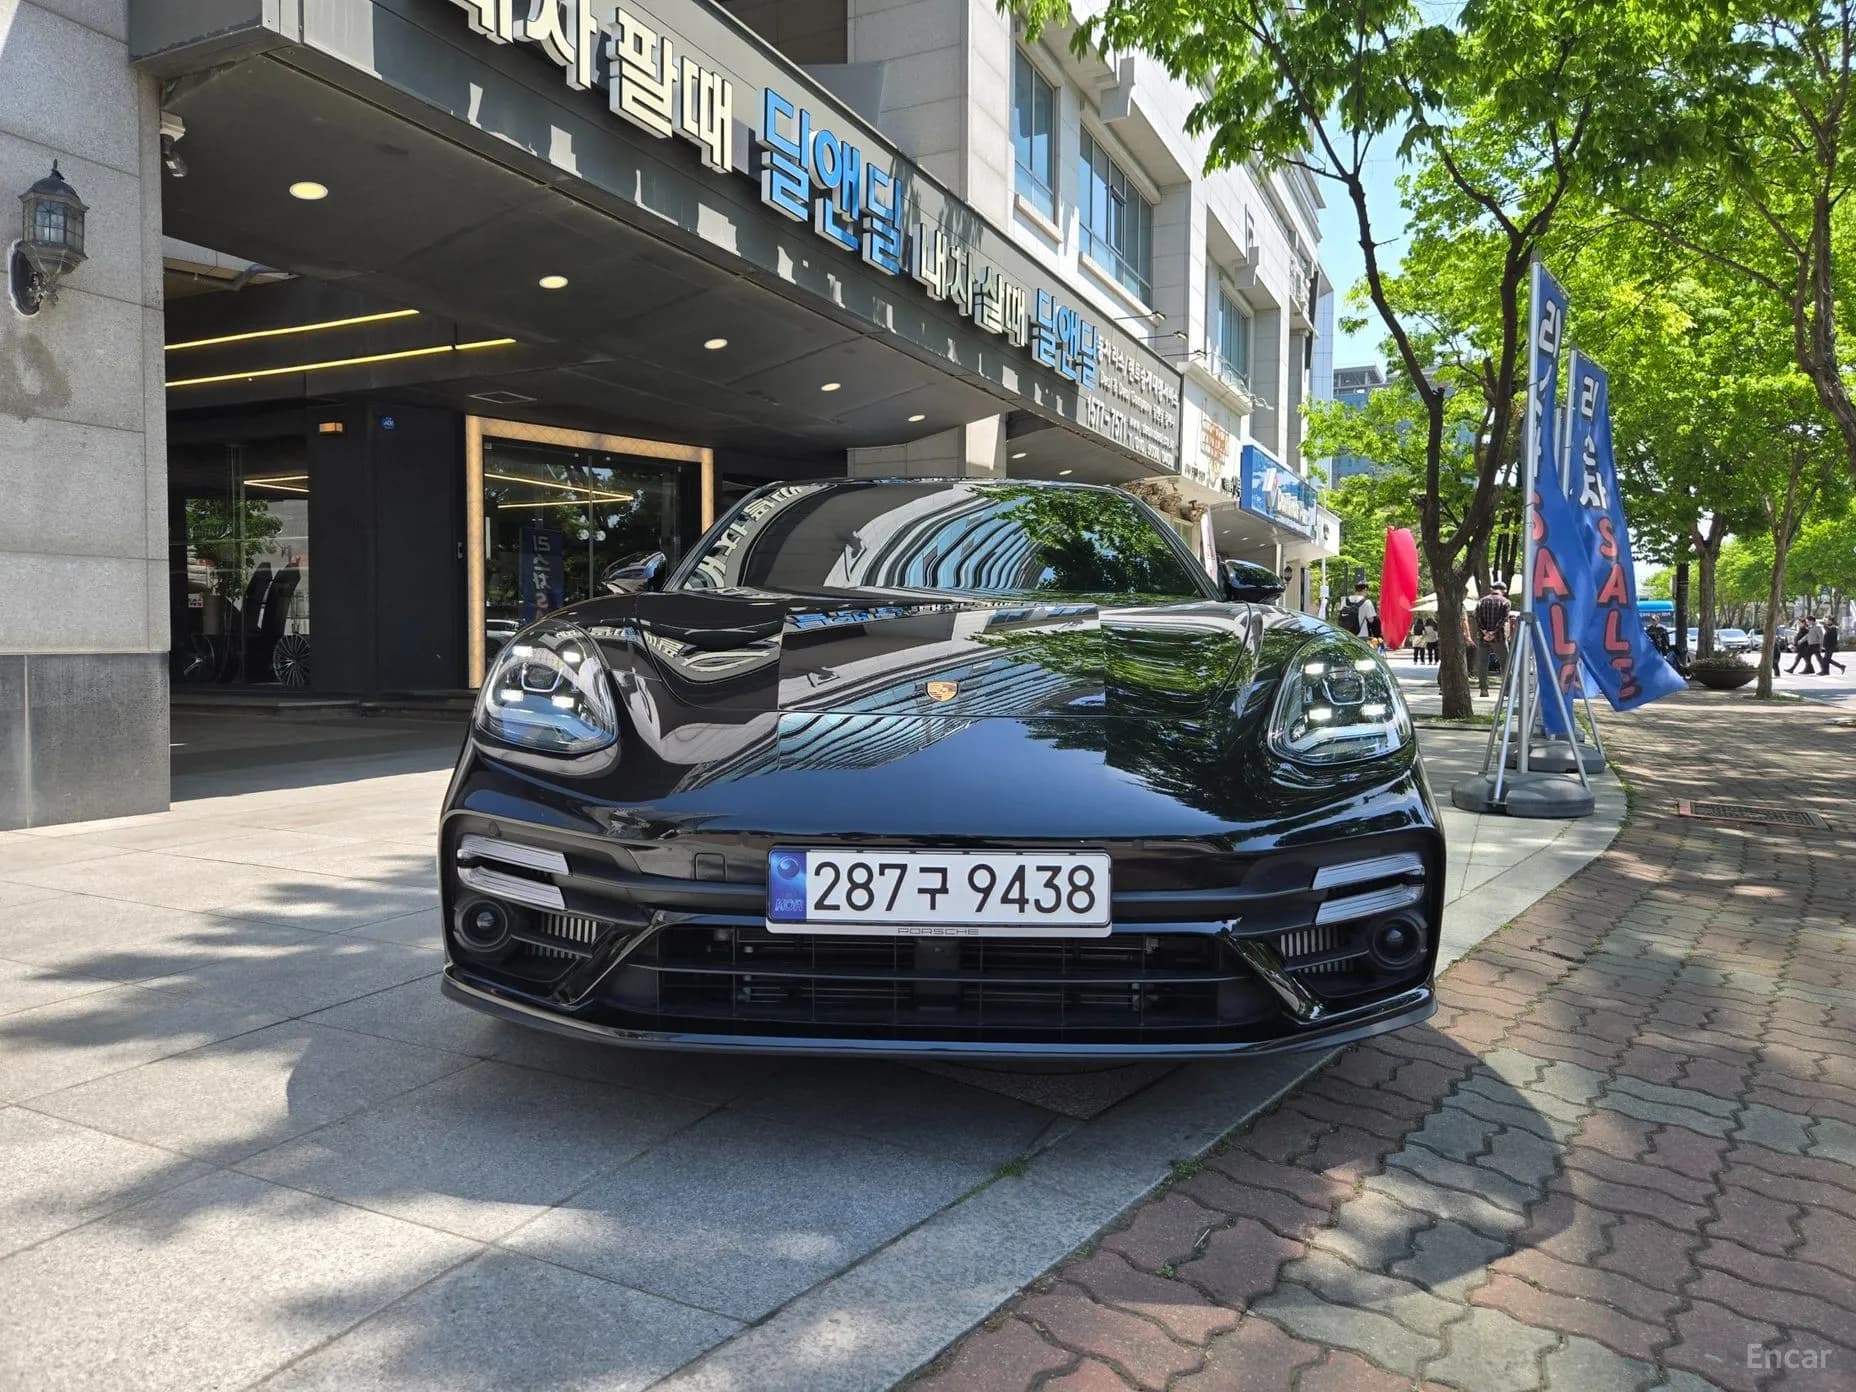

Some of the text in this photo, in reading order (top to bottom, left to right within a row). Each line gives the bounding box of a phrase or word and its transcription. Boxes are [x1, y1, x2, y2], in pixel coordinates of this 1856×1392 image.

[757, 87, 903, 276] 딜앤딜
[1032, 287, 1099, 391] 딜앤딜
[813, 861, 1096, 914] 287구 9438
[897, 927, 980, 936] PORSCHE
